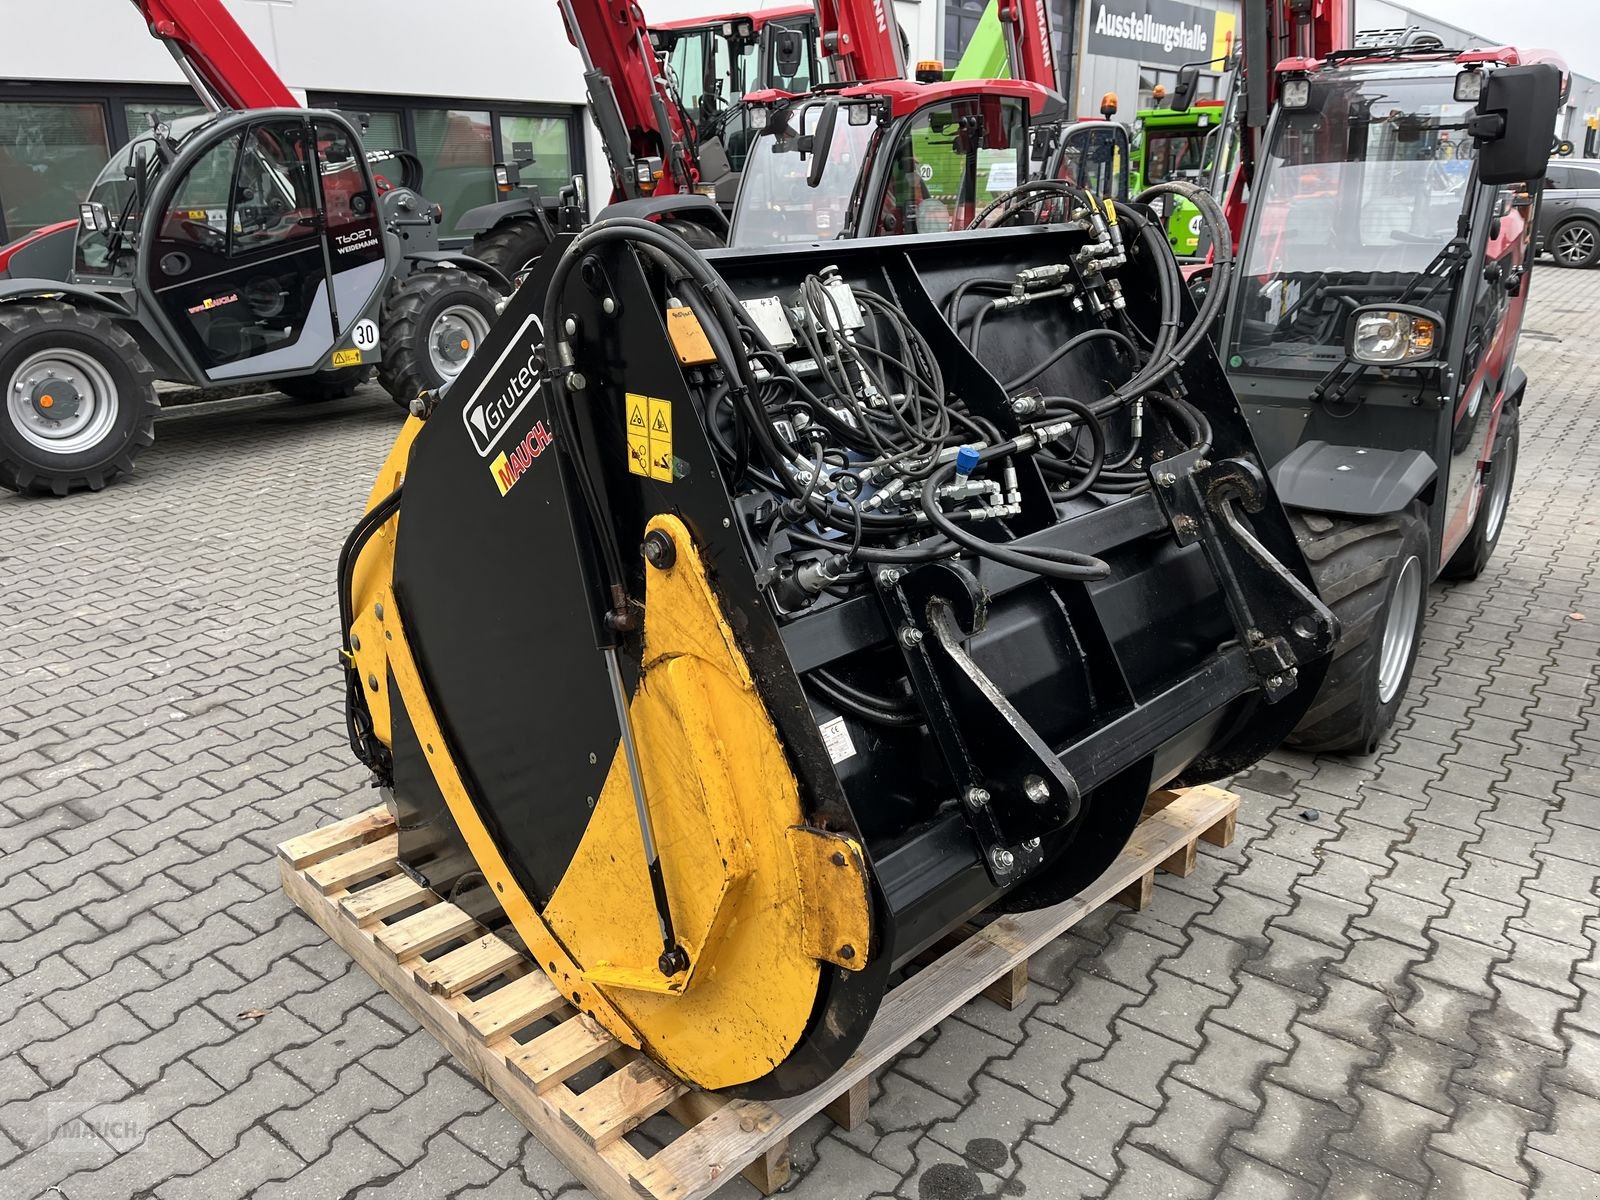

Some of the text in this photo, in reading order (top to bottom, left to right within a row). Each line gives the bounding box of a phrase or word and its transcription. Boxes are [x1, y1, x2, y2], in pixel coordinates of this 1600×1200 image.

[1095, 4, 1208, 53] Ausstellungshalle
[921, 167, 931, 179] 20
[335, 228, 372, 245] T6027
[337, 237, 379, 255] WEIDEMANN
[356, 325, 374, 345] 30
